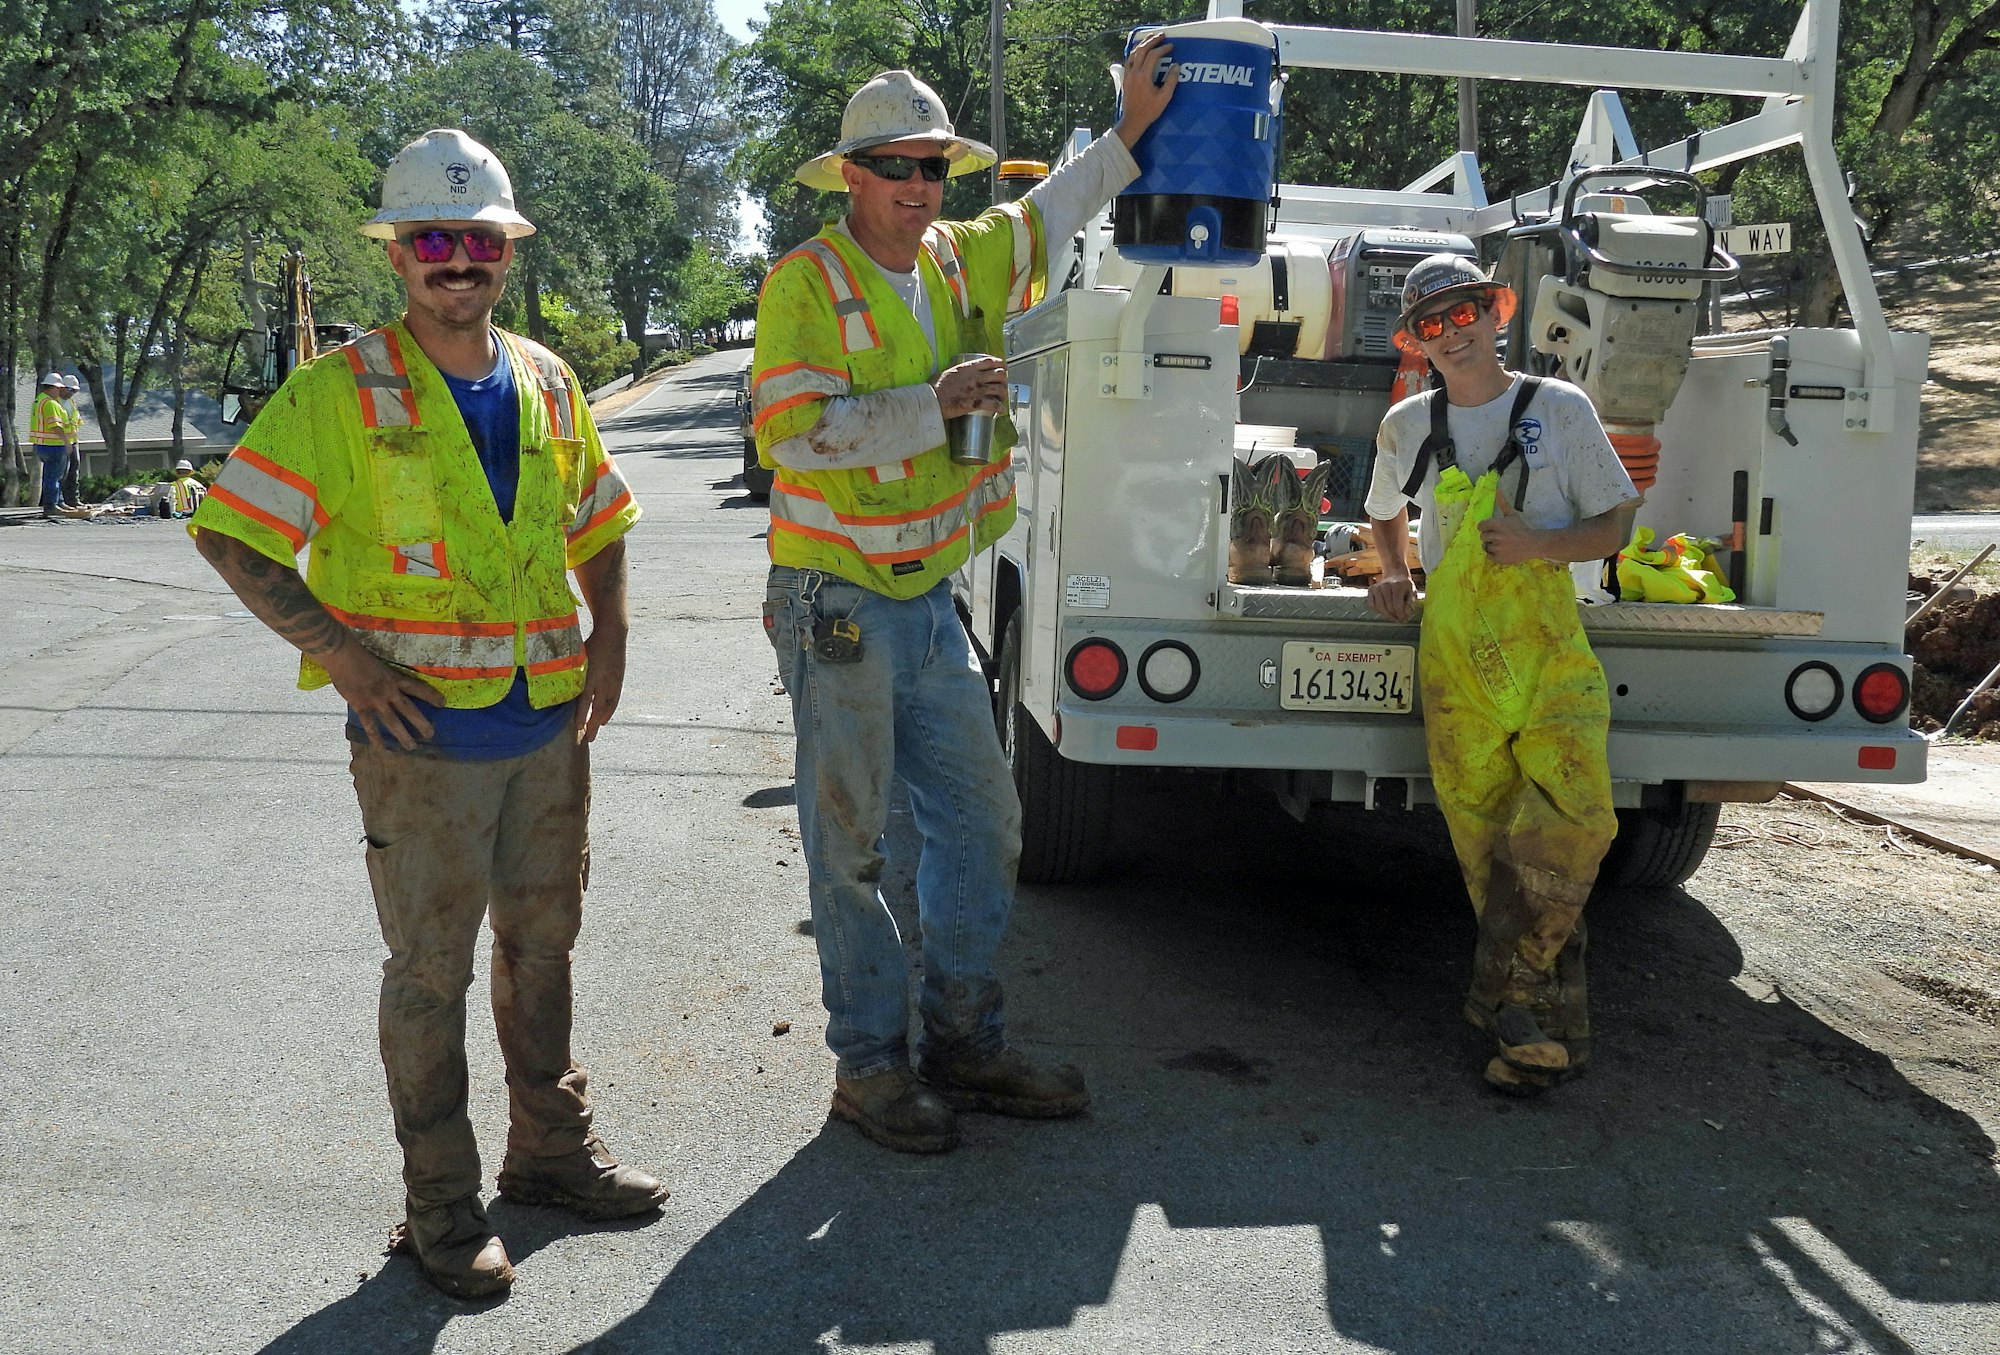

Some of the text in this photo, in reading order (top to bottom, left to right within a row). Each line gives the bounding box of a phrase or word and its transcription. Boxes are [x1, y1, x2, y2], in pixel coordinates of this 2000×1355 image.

[450, 186, 467, 194] NID
[1388, 236, 1449, 245] HONDA
[1749, 227, 1785, 252] WAY
[1522, 445, 1538, 454] ID
[1315, 652, 1383, 663] CA EXEMPT
[1290, 668, 1404, 702] 1613434
